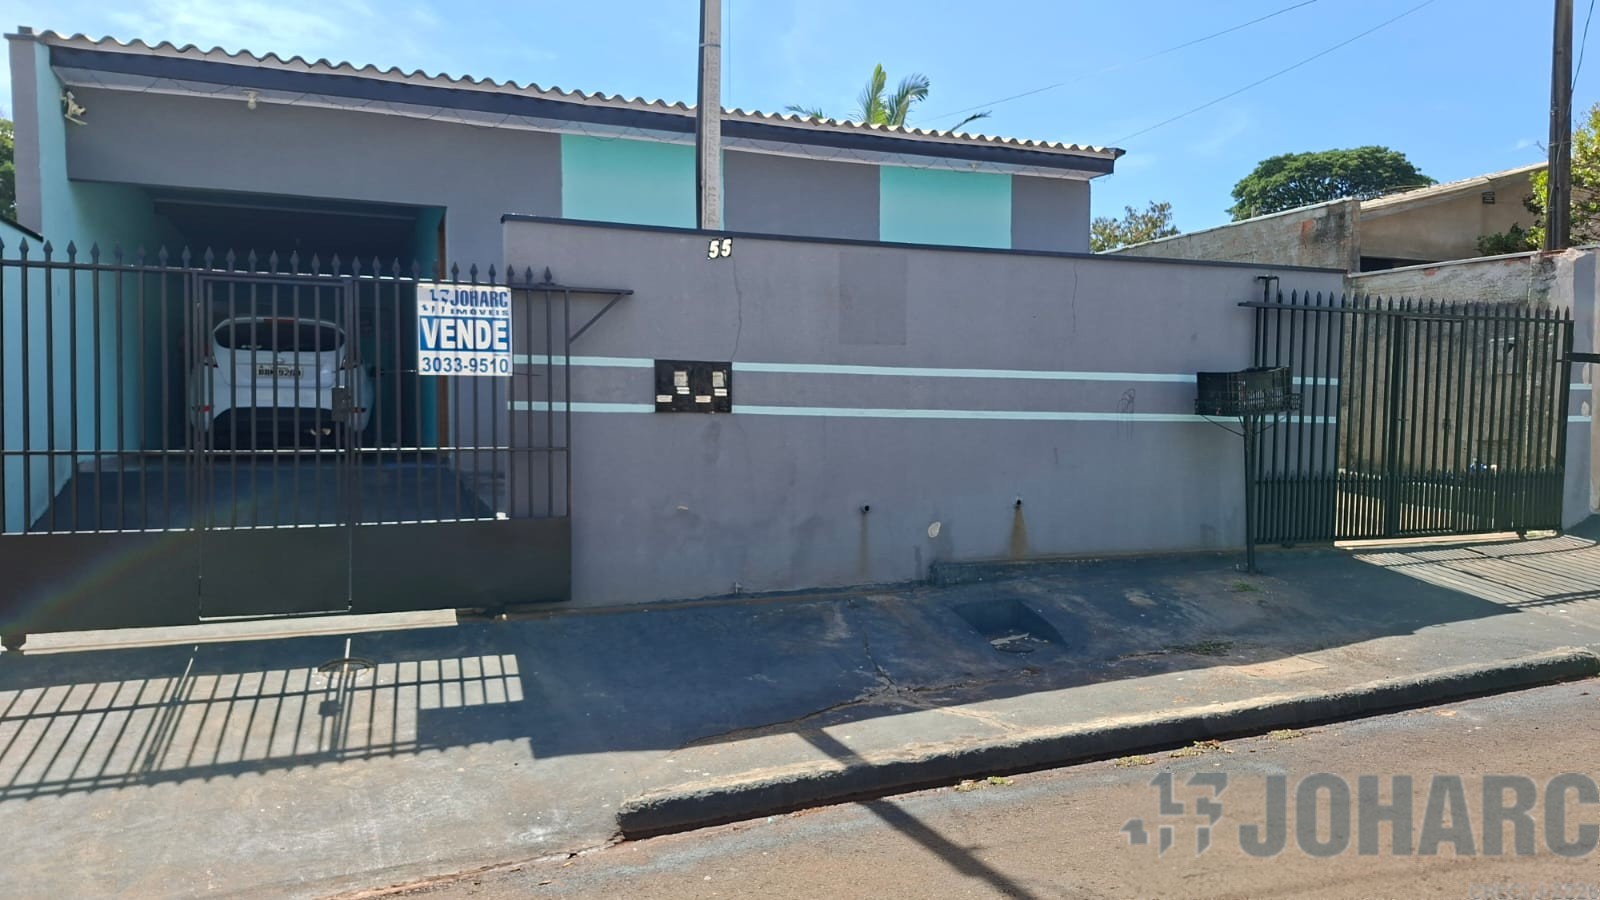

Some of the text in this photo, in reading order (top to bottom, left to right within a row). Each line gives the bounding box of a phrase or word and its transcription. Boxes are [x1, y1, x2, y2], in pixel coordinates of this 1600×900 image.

[708, 238, 732, 259] 55
[450, 289, 508, 308] JOHARC
[421, 319, 508, 350] VENDE
[422, 357, 509, 373] 3033-9510
